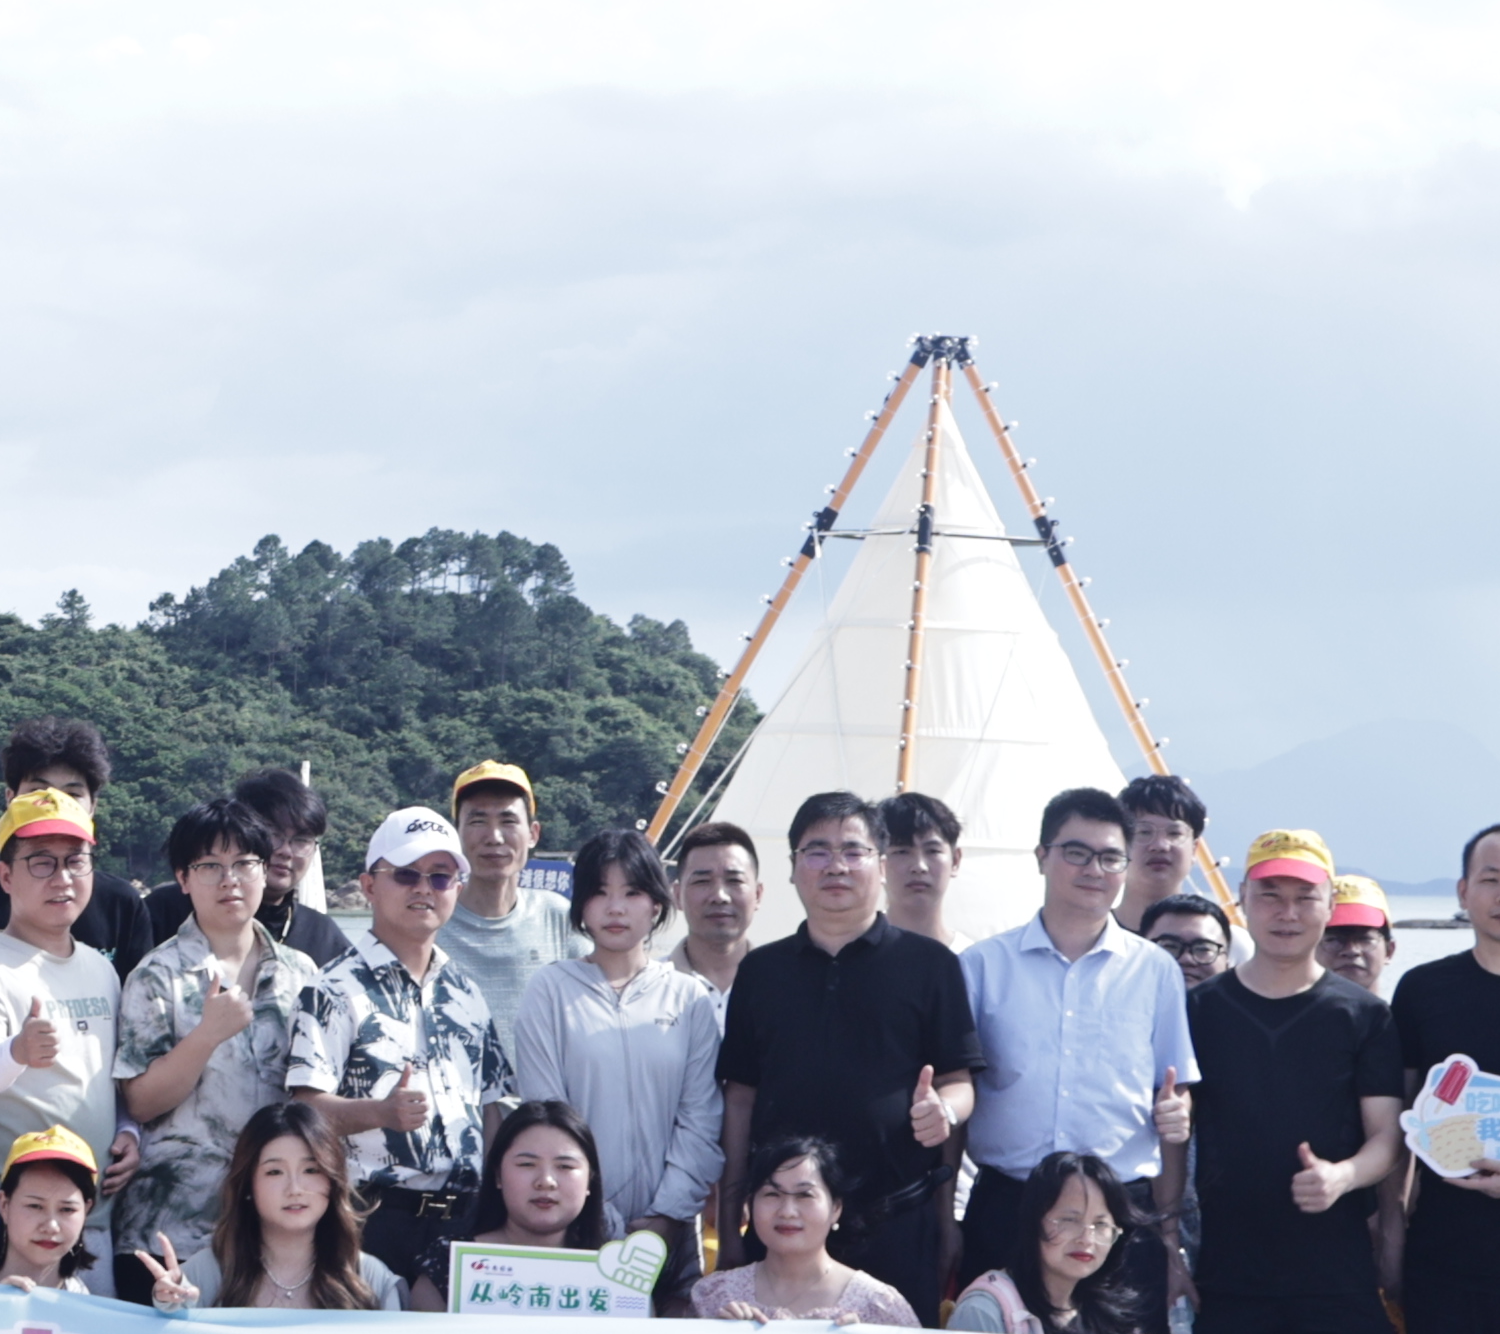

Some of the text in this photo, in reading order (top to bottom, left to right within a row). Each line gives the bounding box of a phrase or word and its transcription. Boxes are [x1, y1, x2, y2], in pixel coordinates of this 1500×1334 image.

[517, 868, 571, 892] 滩很想你
[470, 1282, 610, 1312] 从岭南出发
